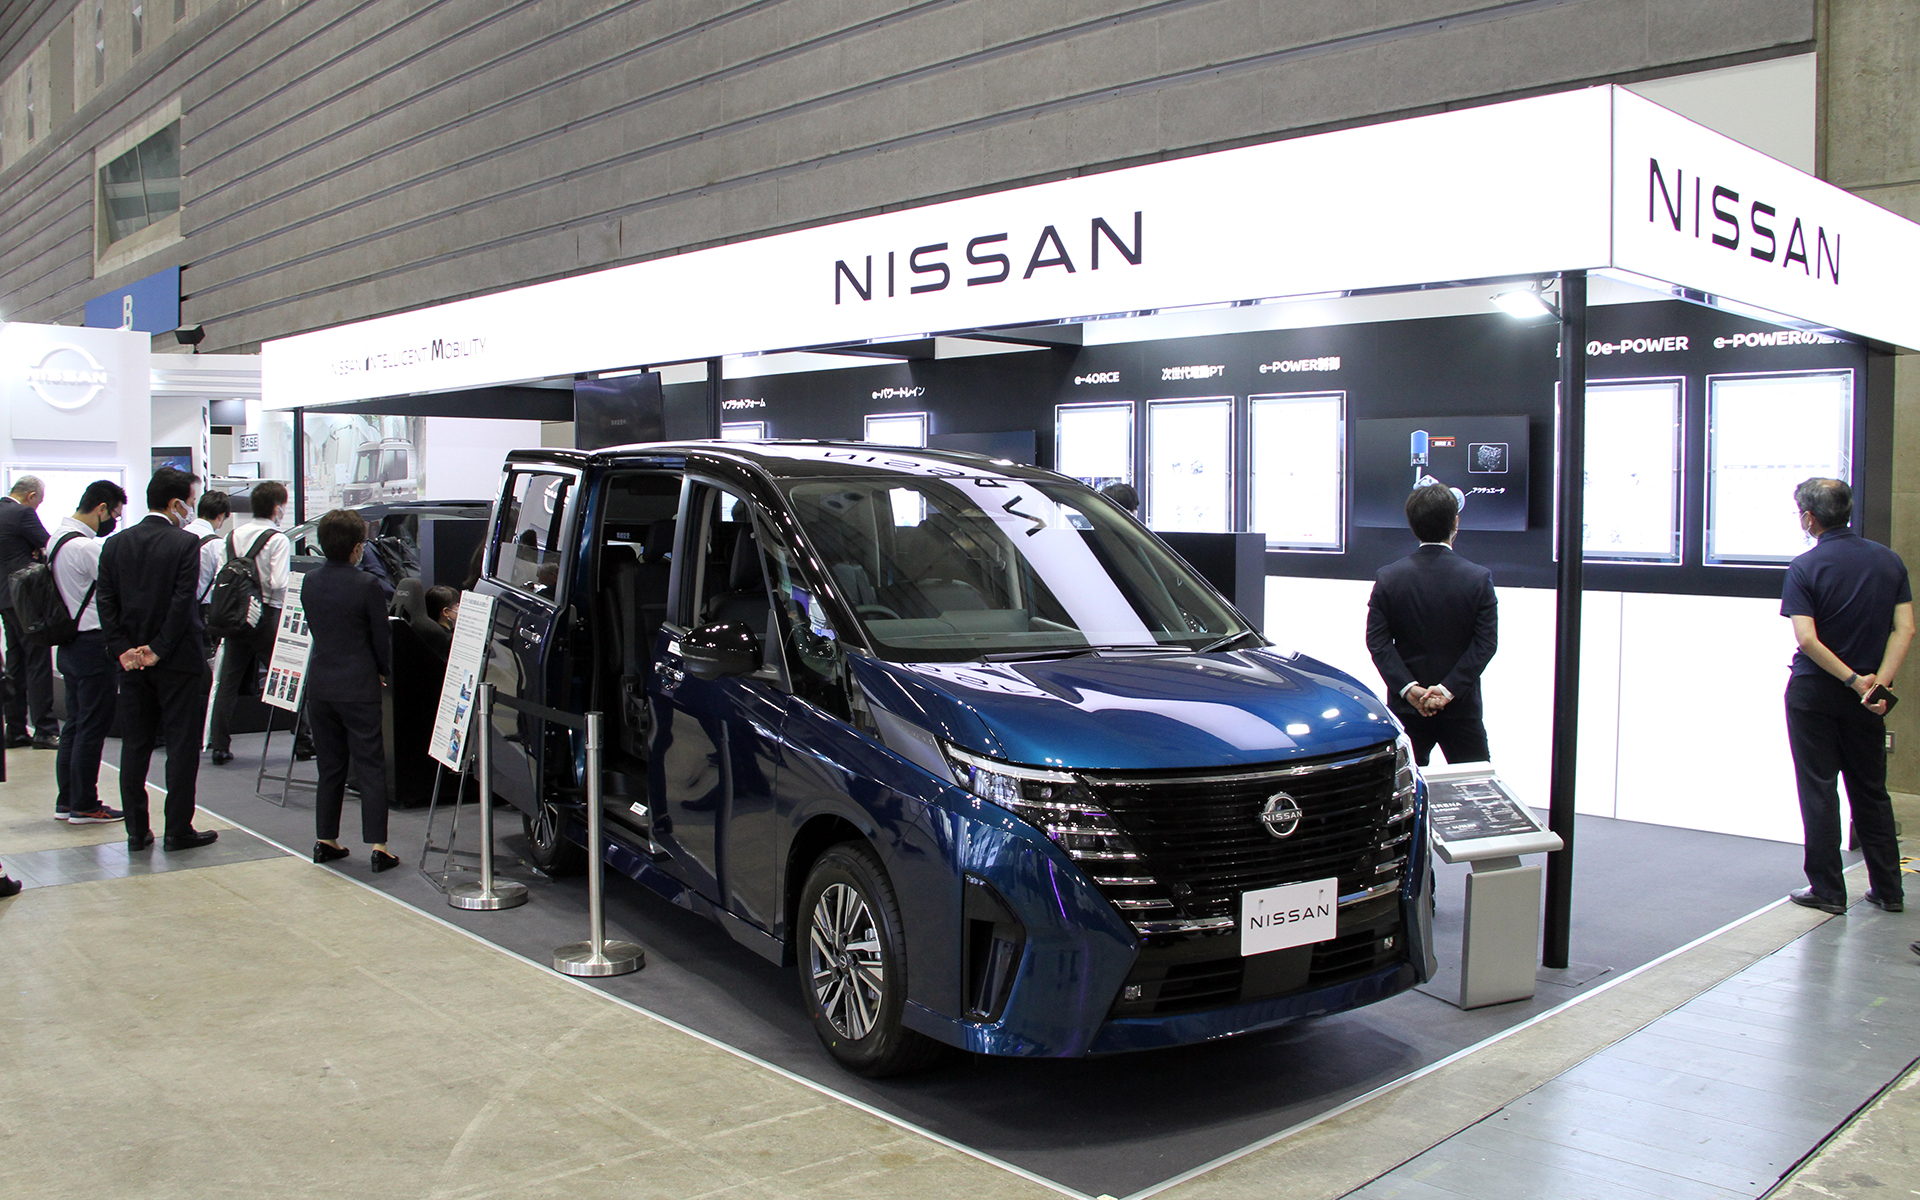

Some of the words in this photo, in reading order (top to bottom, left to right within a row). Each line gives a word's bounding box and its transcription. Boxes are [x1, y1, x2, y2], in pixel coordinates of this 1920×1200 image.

[1649, 157, 1841, 285] NISSAN
[835, 211, 1142, 305] NISSAN
[123, 294, 133, 331] B
[721, 397, 767, 410] Vプラットフォーム
[240, 436, 258, 448] BASE
[1262, 810, 1303, 822] NISSAN
[1250, 904, 1329, 930] NISSAN
